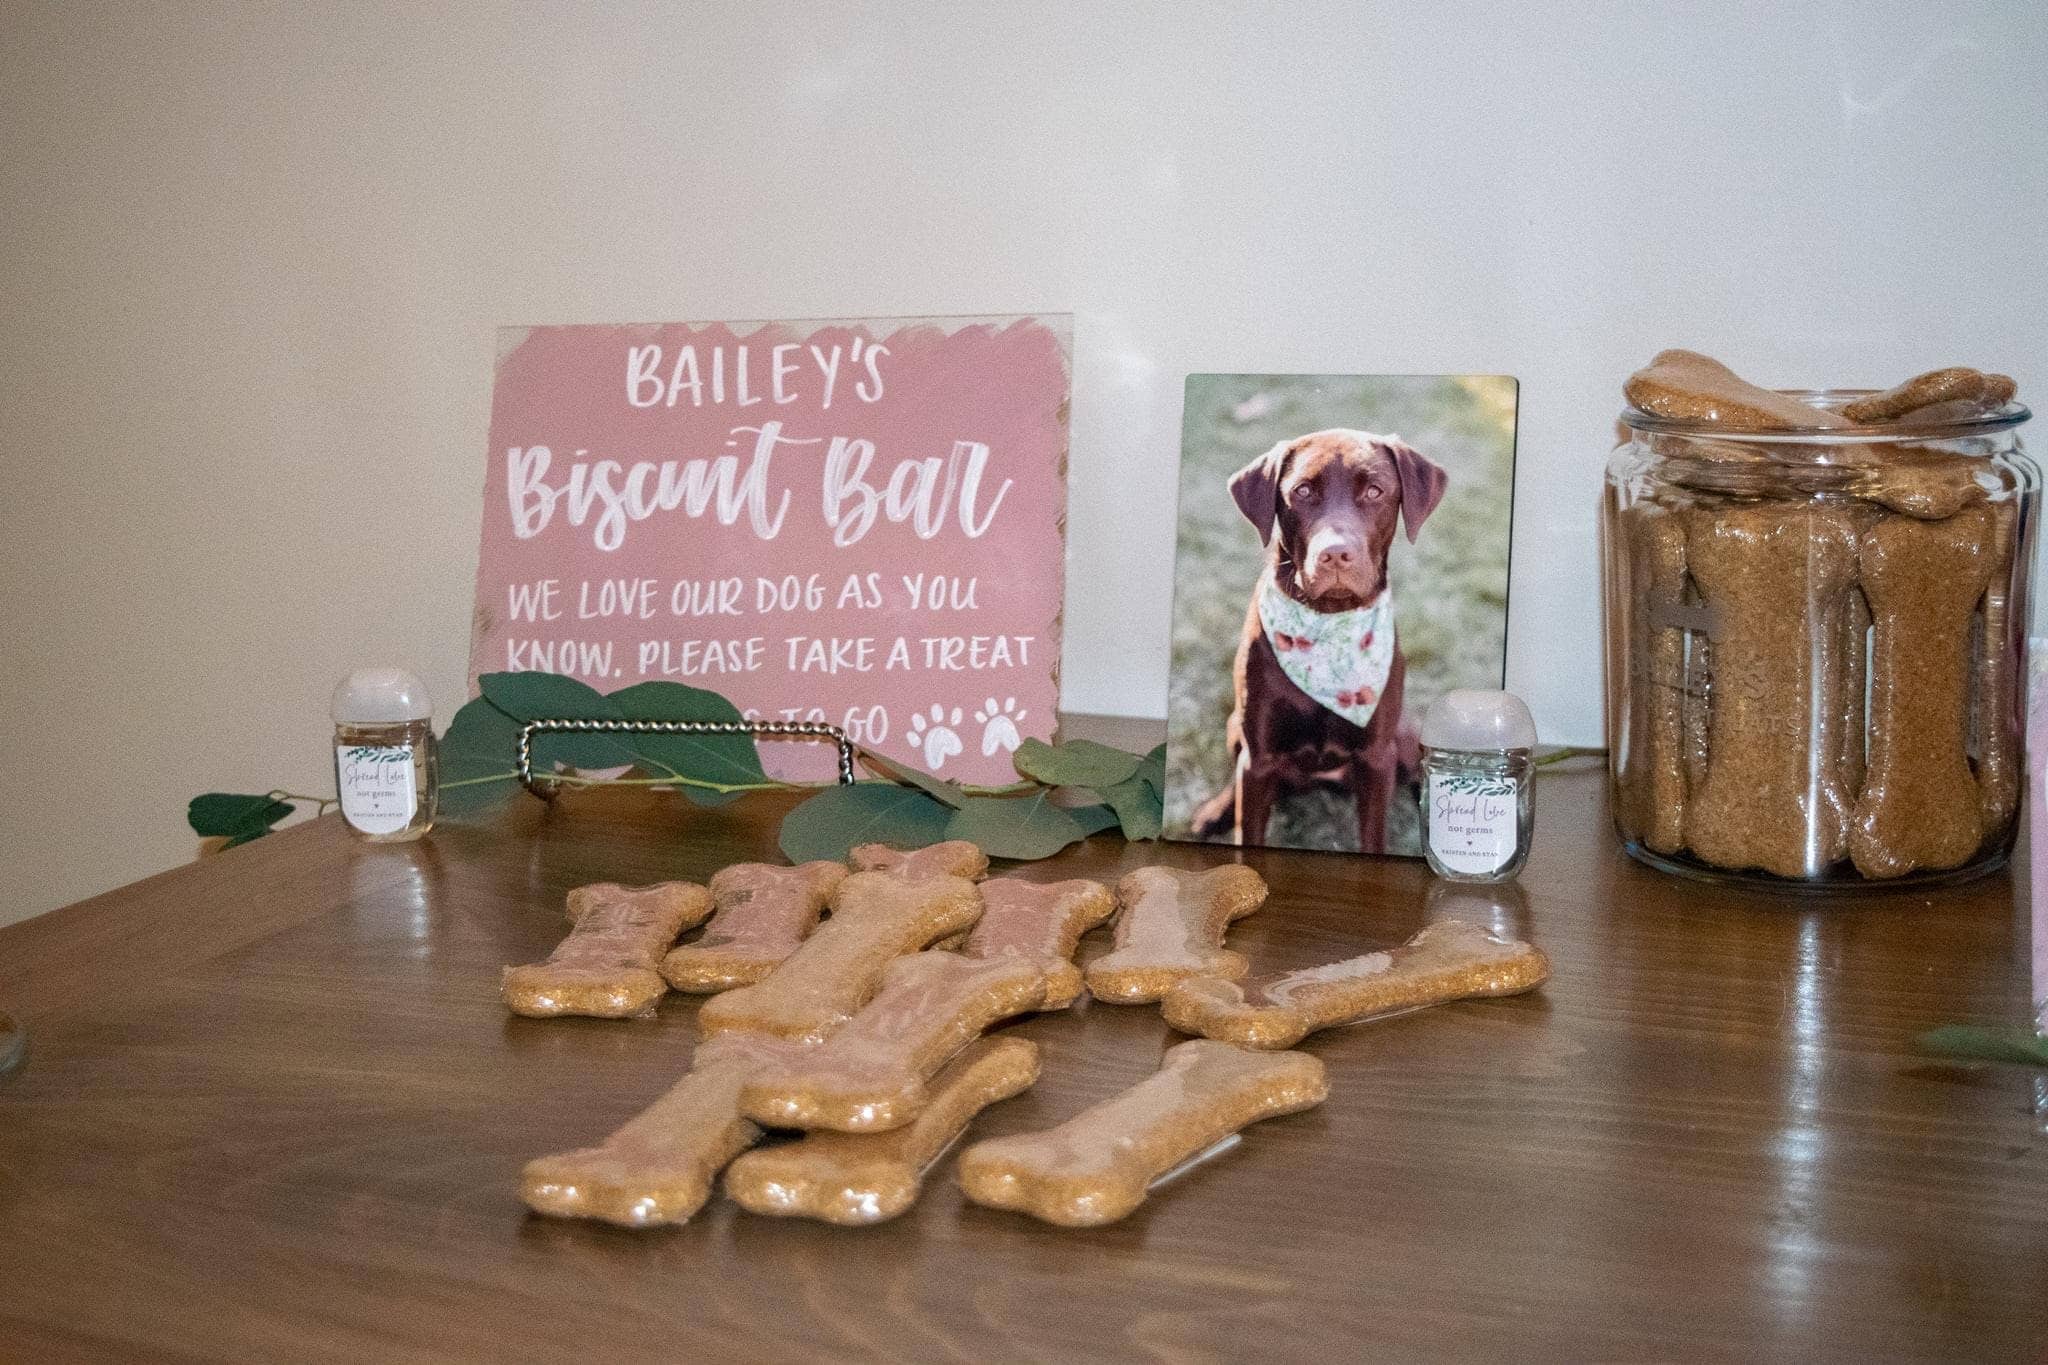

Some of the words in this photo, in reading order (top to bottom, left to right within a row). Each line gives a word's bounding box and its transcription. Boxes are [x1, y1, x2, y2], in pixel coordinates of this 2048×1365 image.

[627, 337, 891, 410] BAILEY'S
[506, 420, 822, 551] Biscuit
[822, 436, 1013, 547] Bar
[508, 579, 562, 622] WE
[579, 577, 658, 620] LOVE
[670, 576, 744, 616] OUR
[756, 573, 826, 614] DOG
[837, 572, 883, 610] AS
[902, 572, 979, 611] YOU
[507, 638, 622, 678] KNOW.
[638, 636, 766, 676] PLEASE
[785, 636, 876, 675] TAKE
[886, 636, 911, 671] A
[919, 634, 1036, 671] TREAT
[842, 705, 889, 745] GO
[1436, 794, 1477, 823] Spread
[1448, 825, 1464, 833] not
[1466, 826, 1494, 836] germs
